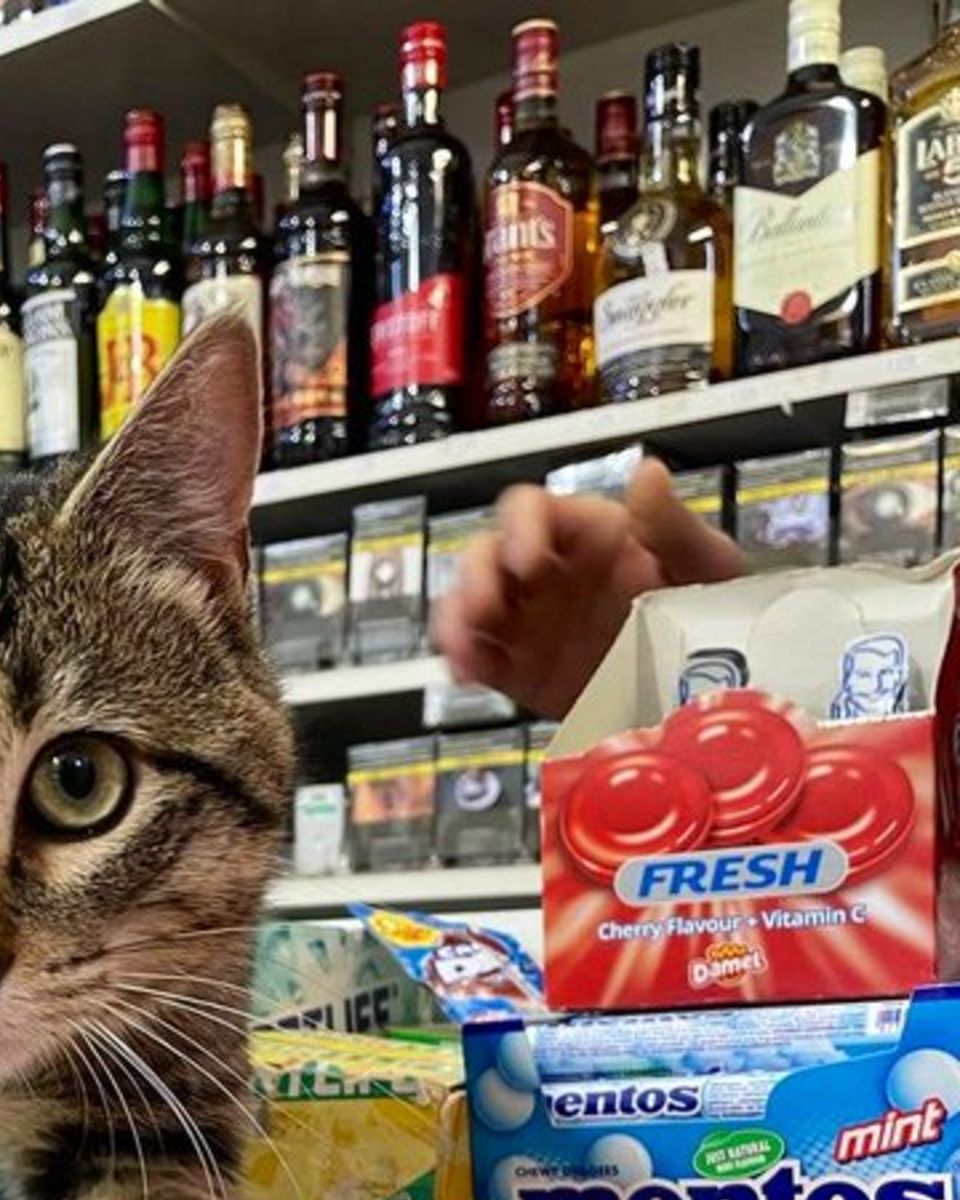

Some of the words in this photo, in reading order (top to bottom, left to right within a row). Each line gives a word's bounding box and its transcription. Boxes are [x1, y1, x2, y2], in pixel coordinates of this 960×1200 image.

[639, 847, 823, 898] FRESH
[597, 921, 661, 942] Cherry
[666, 916, 740, 938] Flavour
[762, 906, 846, 931] Vitamin
[850, 905, 868, 924] C
[691, 949, 762, 985] Damel
[837, 1100, 945, 1162] mint
